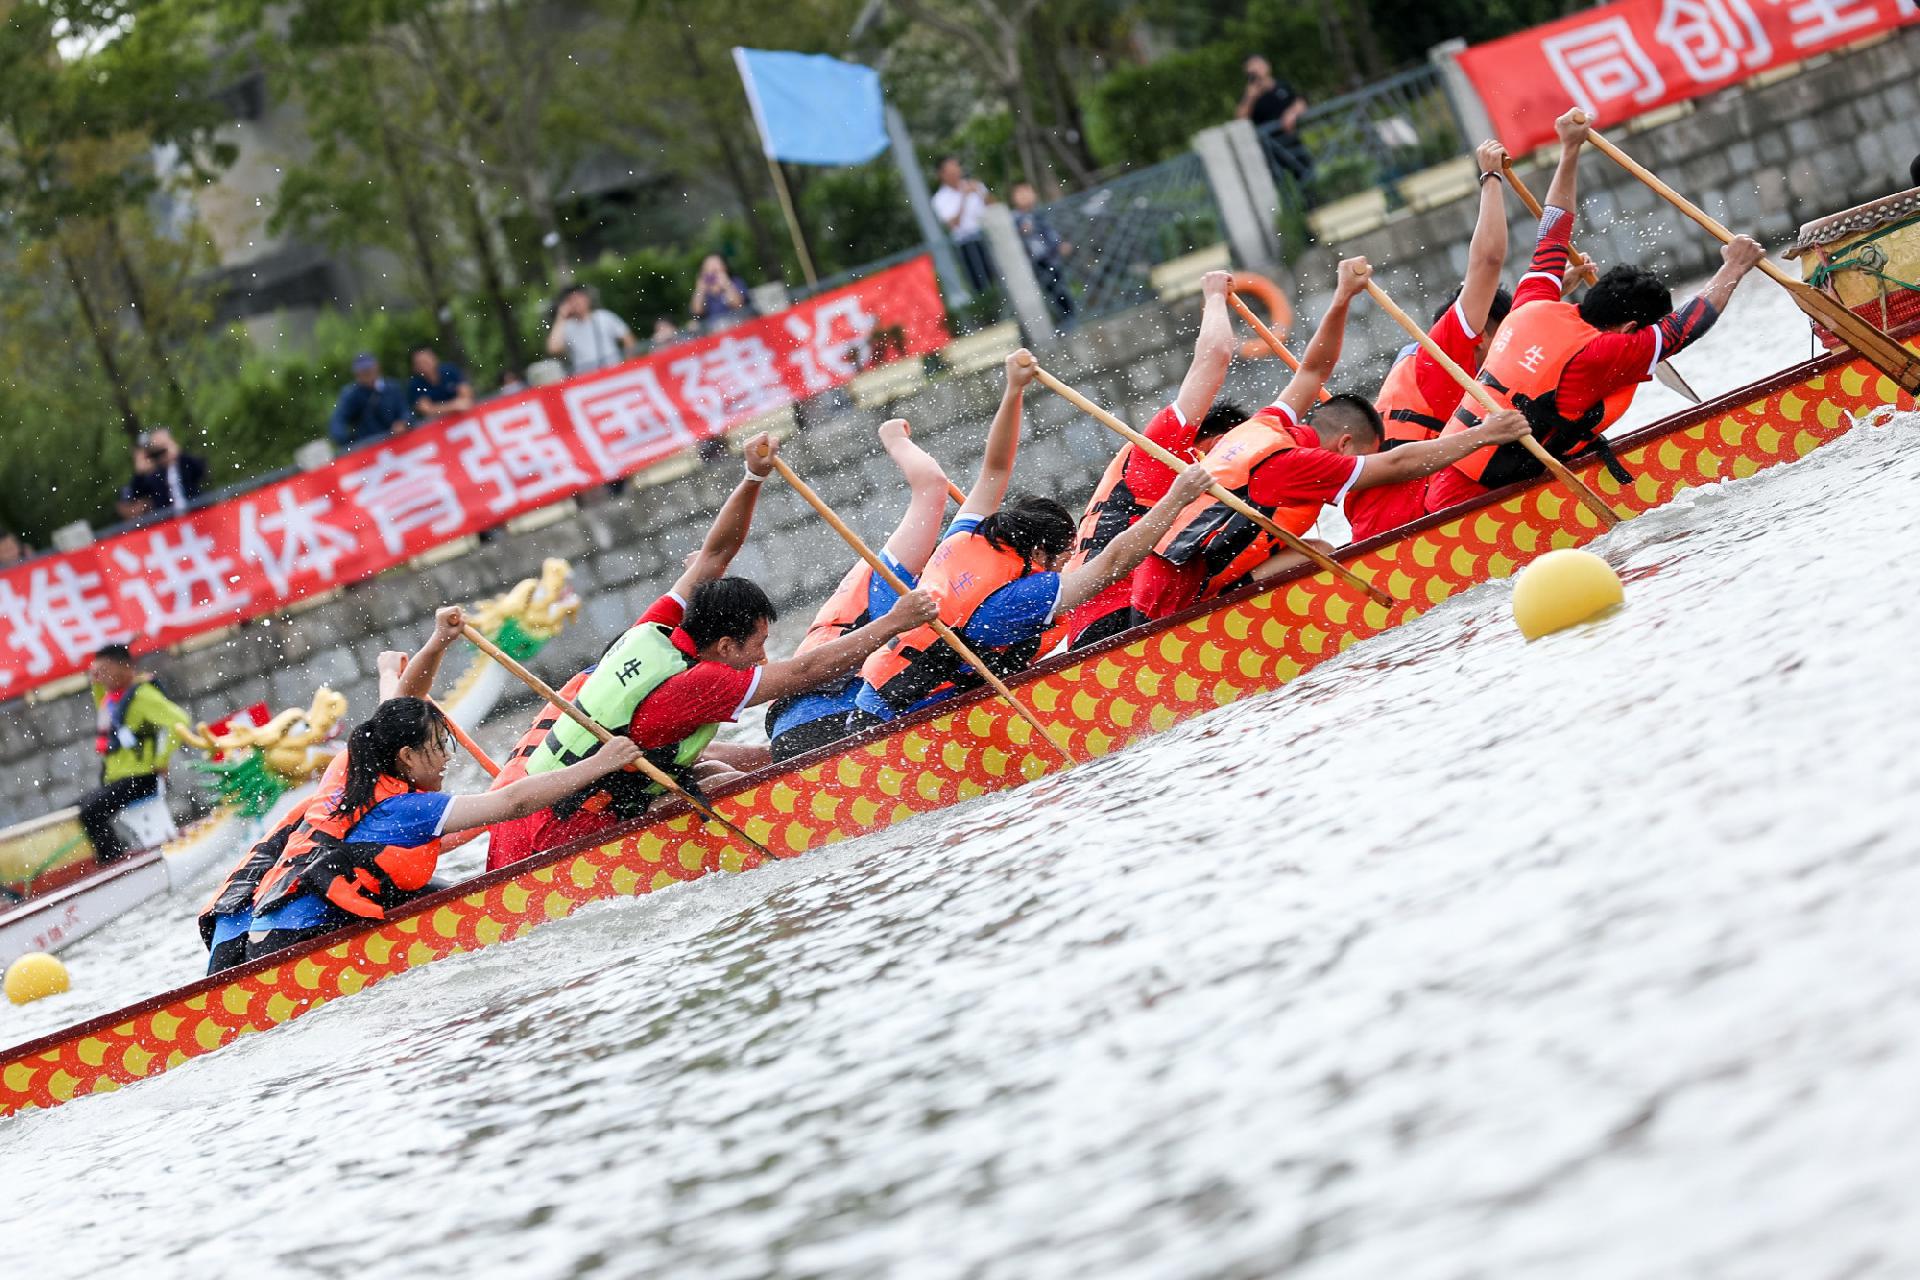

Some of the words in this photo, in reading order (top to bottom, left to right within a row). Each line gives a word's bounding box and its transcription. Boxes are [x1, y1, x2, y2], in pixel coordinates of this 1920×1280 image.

[0, 295, 876, 686] 推进体育强国建设
